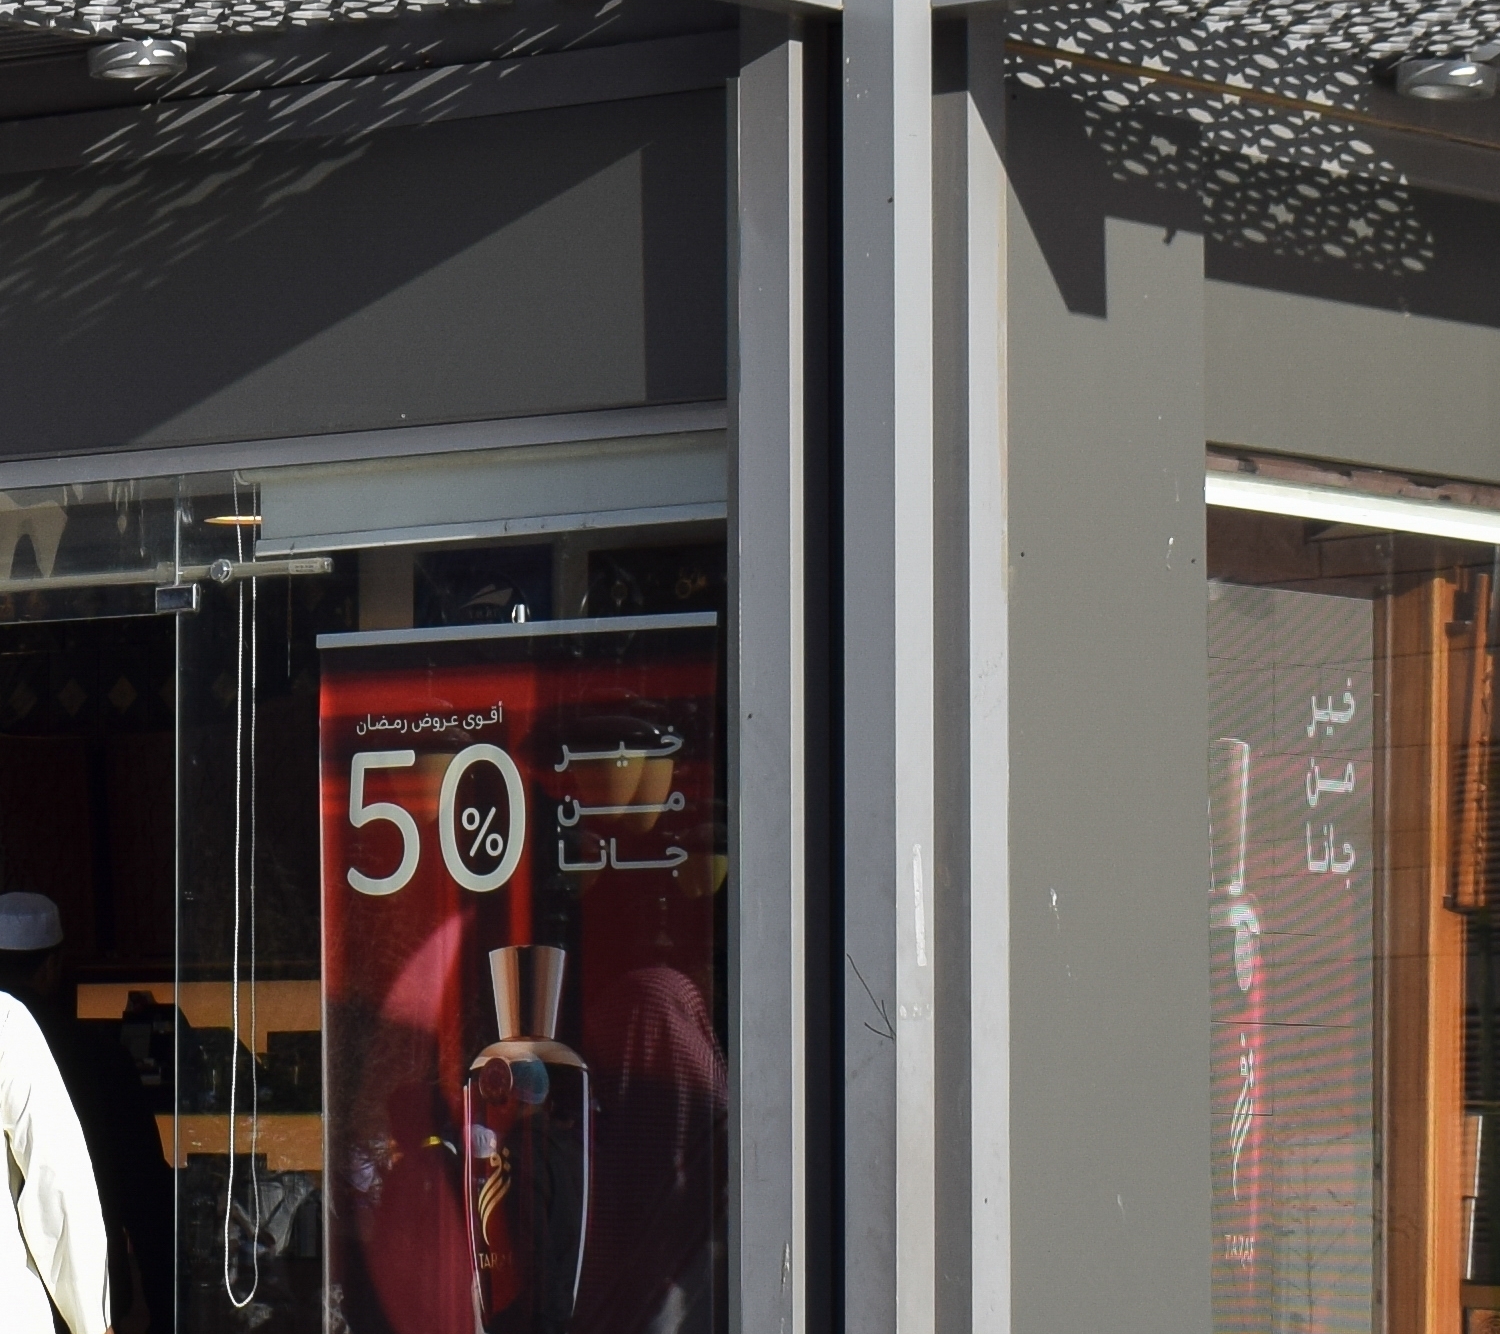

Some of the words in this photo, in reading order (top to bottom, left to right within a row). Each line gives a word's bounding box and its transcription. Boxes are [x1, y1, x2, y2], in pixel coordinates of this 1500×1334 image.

[356, 713, 408, 736] رمضان
[411, 713, 459, 733] عروض
[462, 700, 504, 730] أقوى
[553, 725, 684, 773] خير
[556, 790, 686, 828] من
[557, 837, 689, 878] جانا
